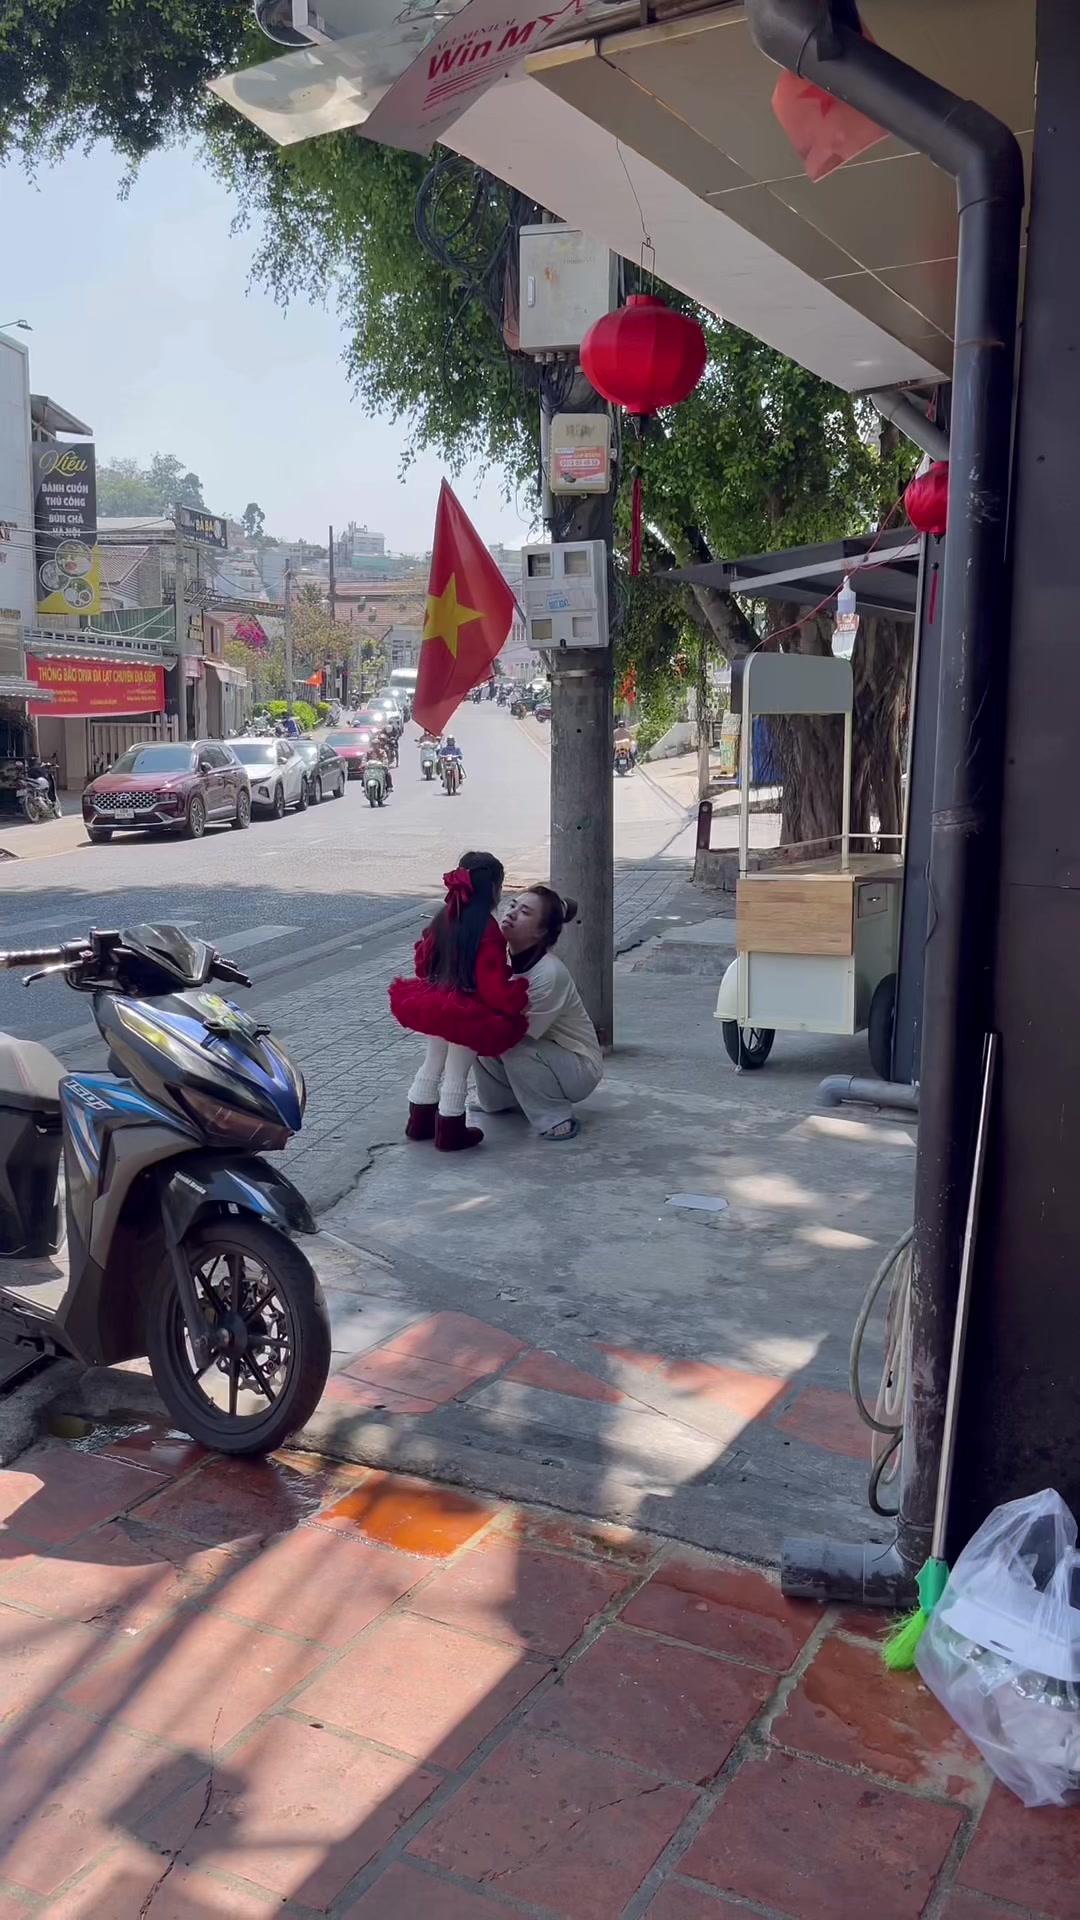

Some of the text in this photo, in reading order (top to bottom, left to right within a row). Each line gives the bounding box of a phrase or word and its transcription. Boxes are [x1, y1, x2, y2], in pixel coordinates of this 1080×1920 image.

[428, 40, 493, 80] Win
[41, 482, 89, 493] BÁNH CUỐN
[63, 496, 86, 506] CÔNG
[38, 664, 62, 681] THÔNG
[63, 665, 77, 681] BÁO
